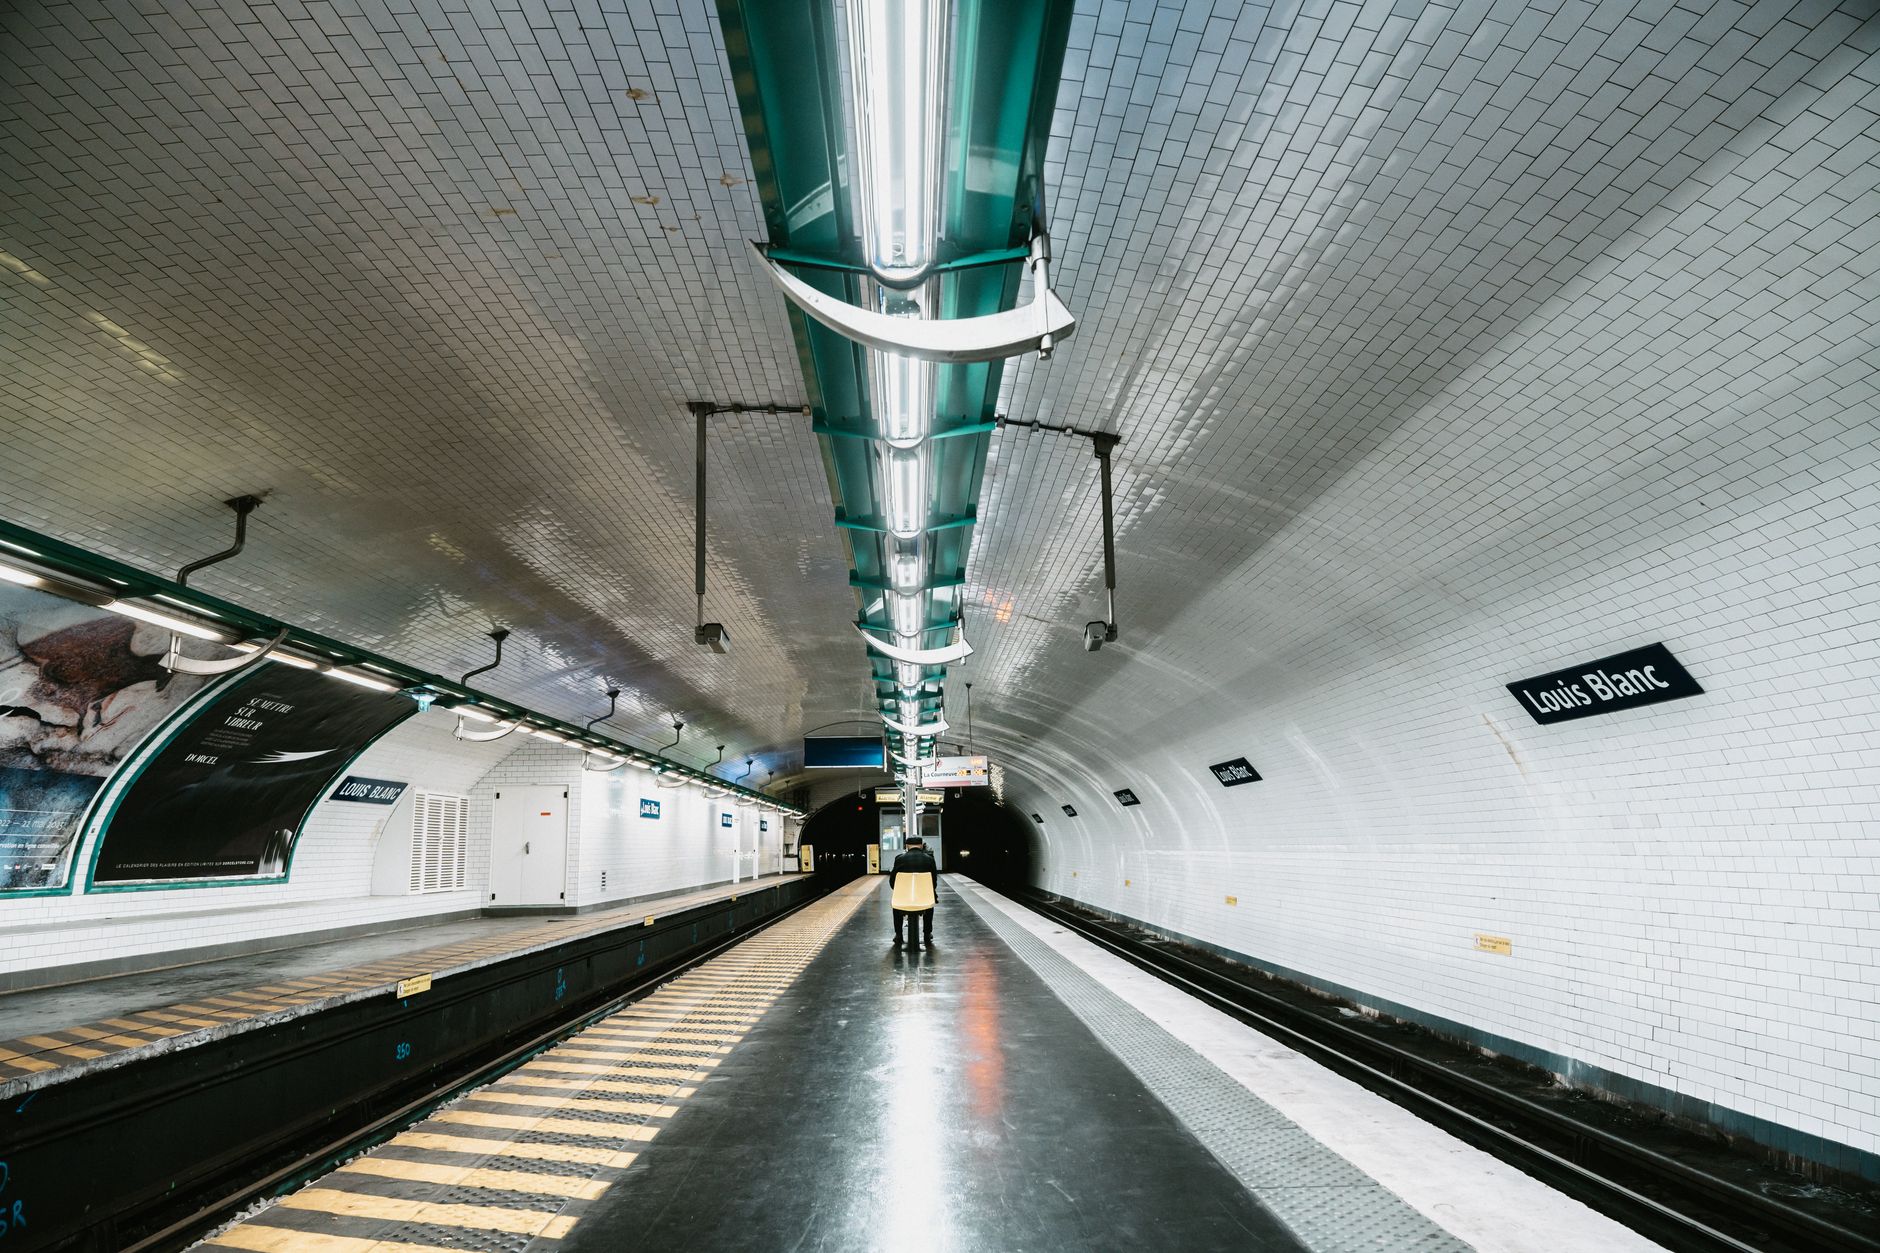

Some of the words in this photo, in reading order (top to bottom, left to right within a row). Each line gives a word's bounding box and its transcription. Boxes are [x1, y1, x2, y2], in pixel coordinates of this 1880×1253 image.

[1522, 679, 1592, 714] Louis
[1581, 664, 1670, 702] Blanc
[234, 706, 257, 718] SUR
[246, 697, 263, 707] SE
[260, 699, 295, 714] METTRE
[224, 715, 263, 731] VIBREUR
[184, 753, 219, 765] DORCEL
[1214, 767, 1236, 782] Louis
[1229, 764, 1252, 779] Blanc
[339, 782, 372, 798] LOUIS
[368, 785, 401, 800] BLANC
